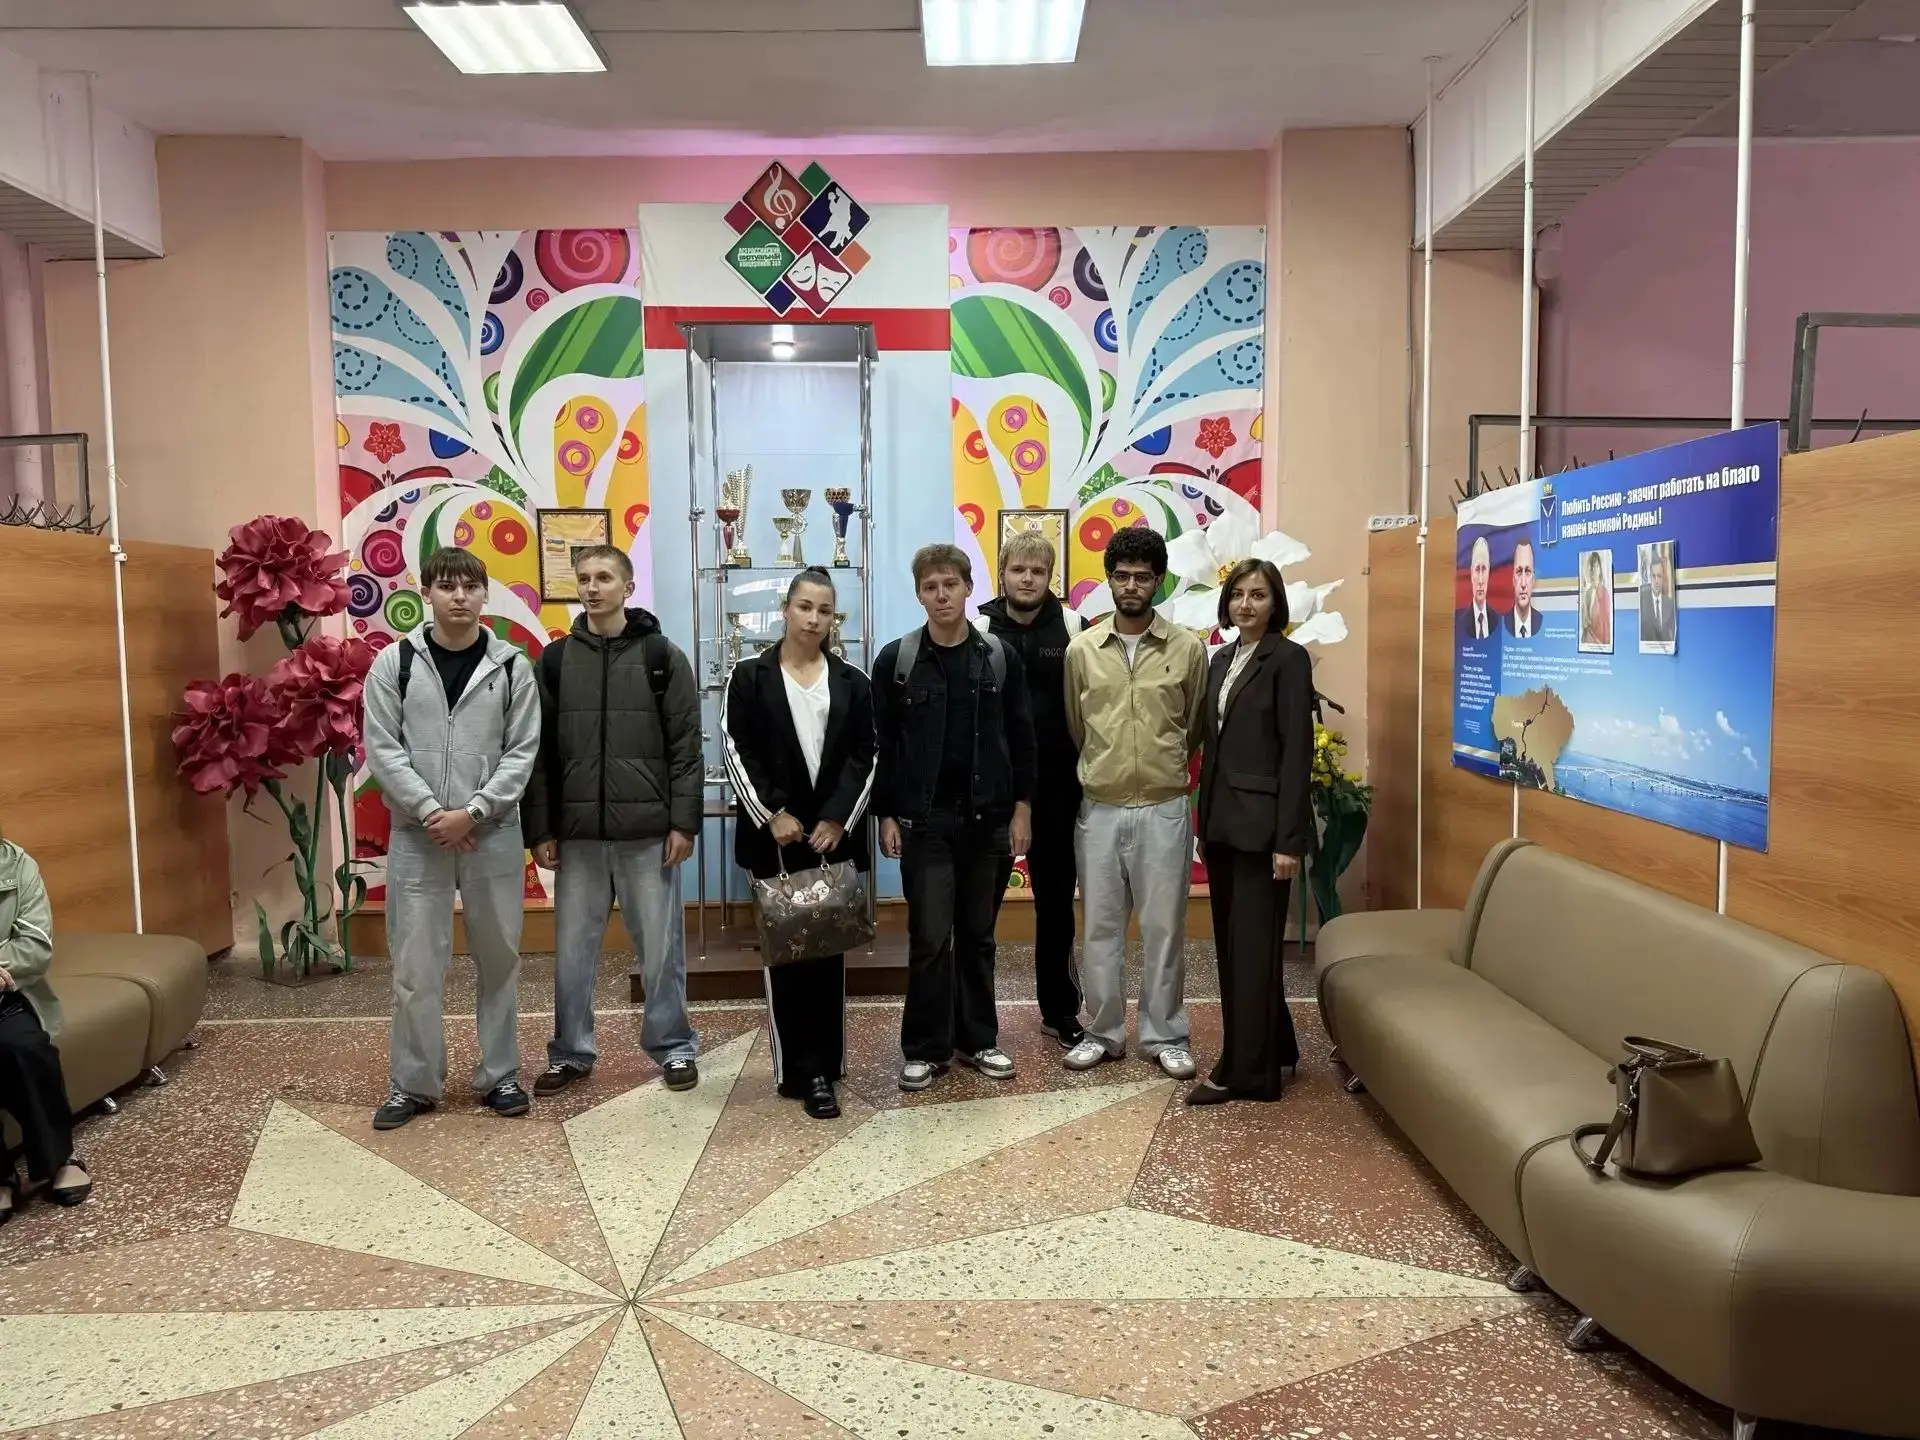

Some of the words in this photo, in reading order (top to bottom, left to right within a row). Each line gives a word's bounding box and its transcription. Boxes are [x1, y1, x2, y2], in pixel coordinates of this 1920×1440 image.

[1561, 498, 1591, 516] Любить
[1591, 492, 1622, 511] Россию
[1627, 484, 1658, 504] значит
[1660, 477, 1705, 500] работать
[1706, 472, 1720, 490] на
[1721, 464, 1760, 487] благо
[1561, 519, 1587, 539] нашей
[1587, 513, 1621, 535] великой
[1622, 510, 1657, 531] Родины
